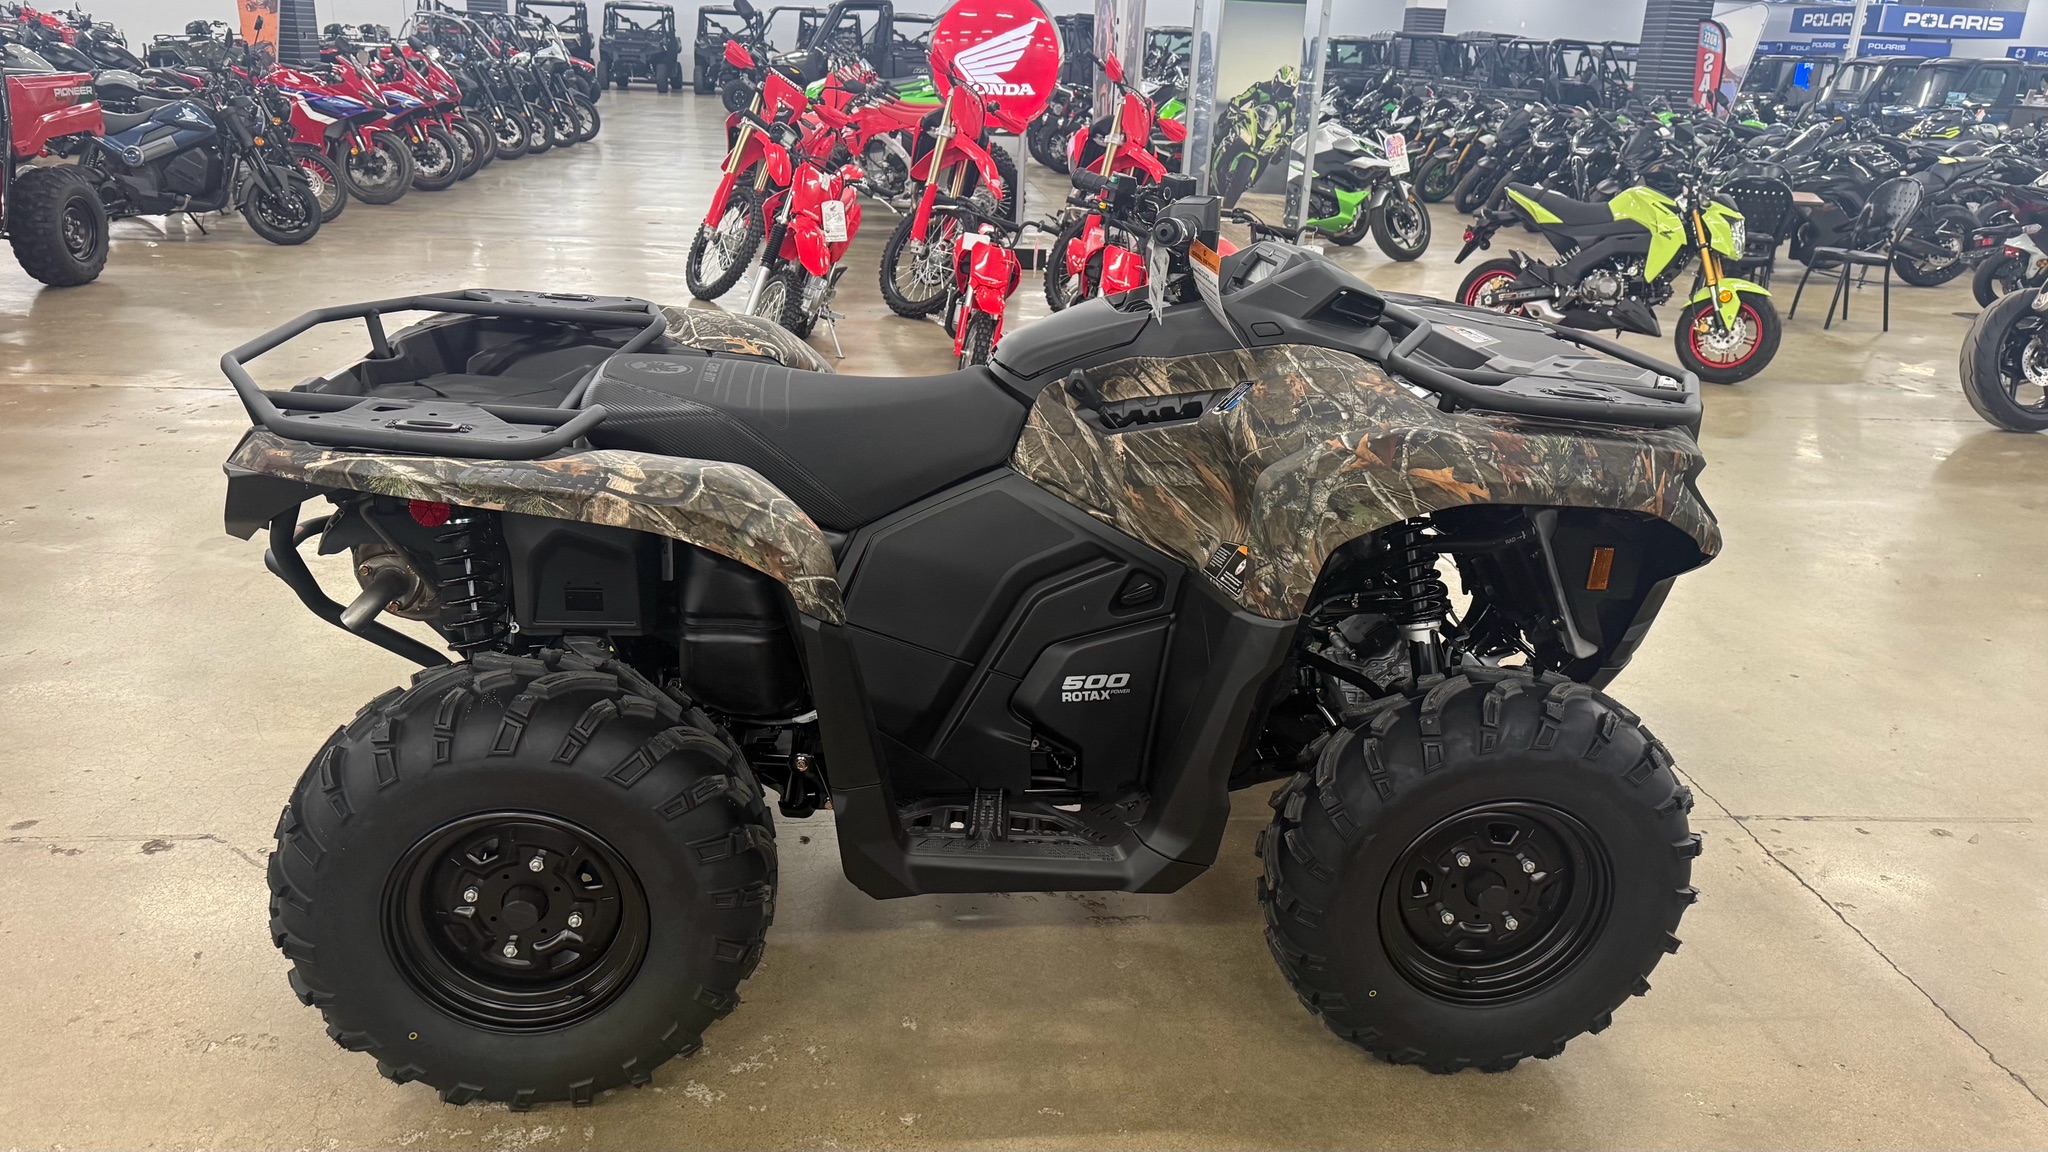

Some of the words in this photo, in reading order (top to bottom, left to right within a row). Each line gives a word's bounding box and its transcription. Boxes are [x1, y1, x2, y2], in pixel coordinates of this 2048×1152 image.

[1802, 12, 1867, 27] POLAR
[1903, 12, 2004, 31] POLARIS
[1867, 42, 1907, 51] POLARIS
[53, 86, 93, 97] PIONEER
[966, 83, 1036, 96] ONDA
[1062, 673, 1130, 690] 500
[1062, 690, 1111, 702] ROTAX
